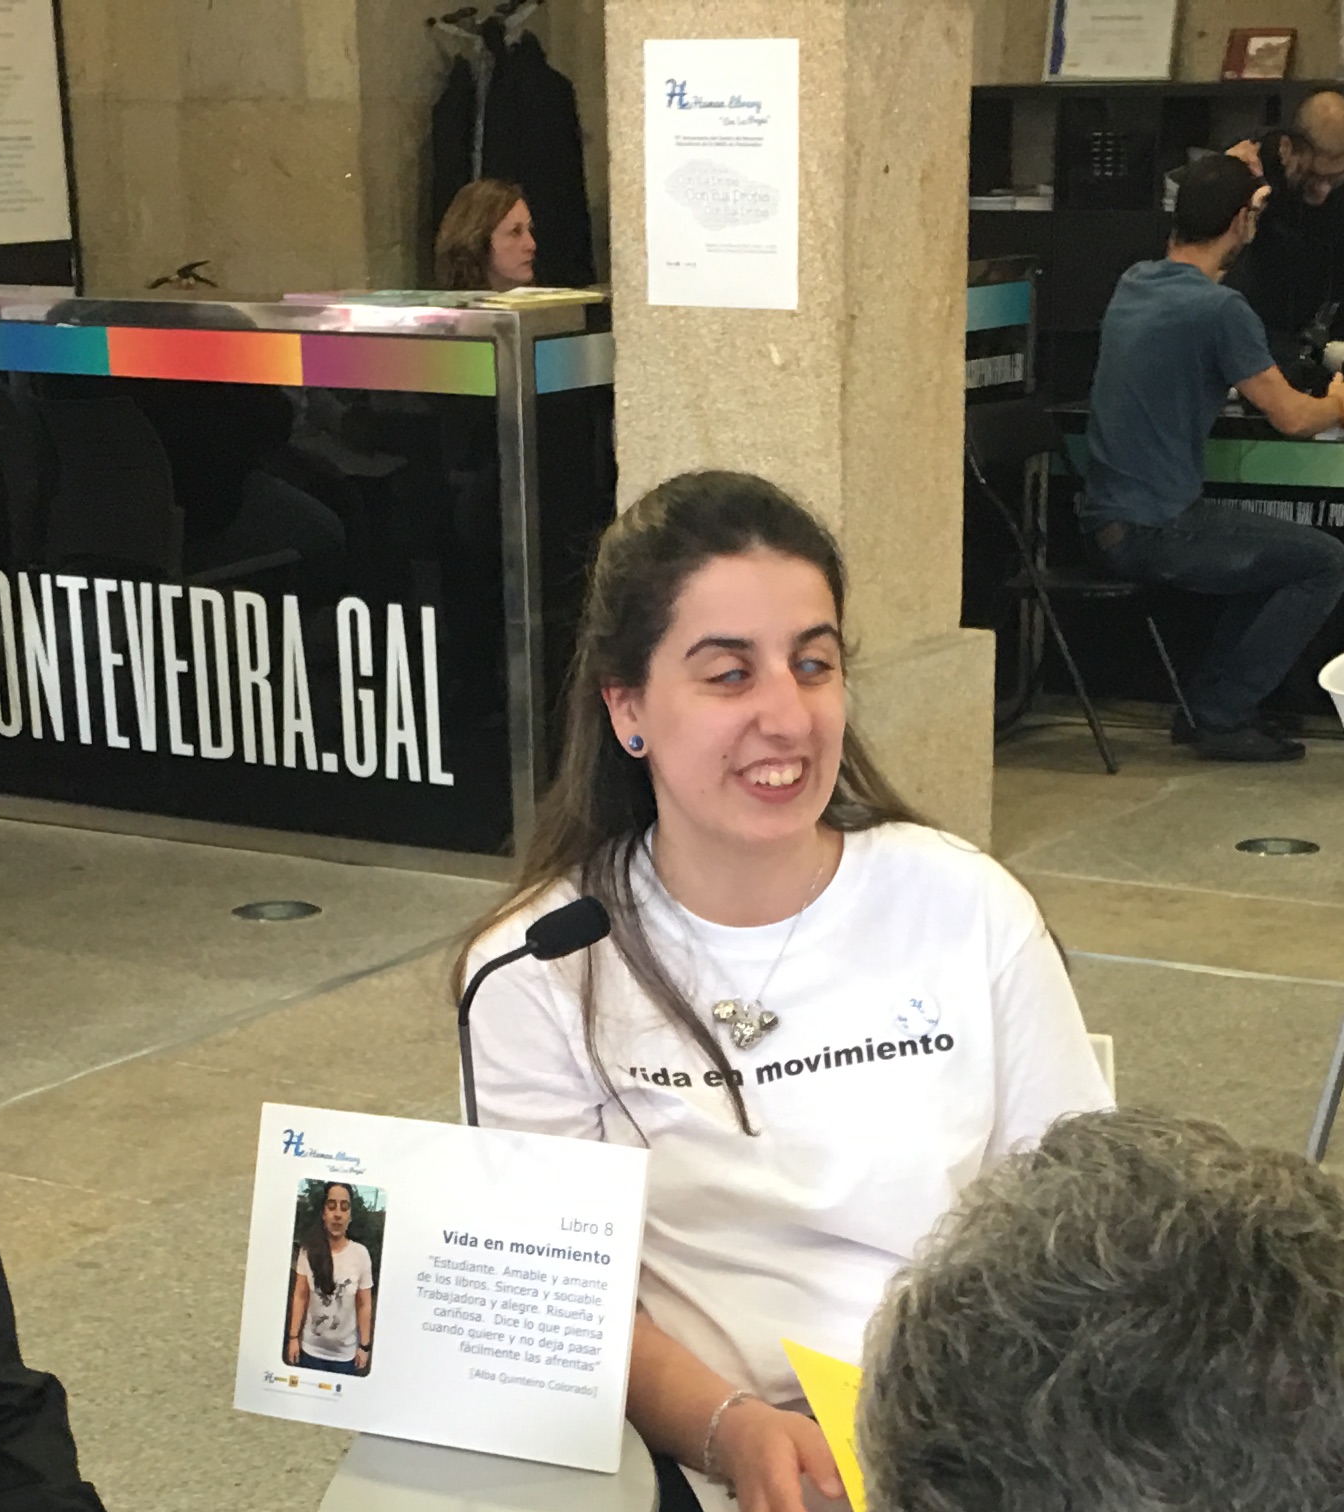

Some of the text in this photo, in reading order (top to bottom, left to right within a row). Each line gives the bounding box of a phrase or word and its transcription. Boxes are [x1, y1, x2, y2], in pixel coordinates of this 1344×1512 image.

[629, 1066, 692, 1088] ida
[755, 1032, 954, 1085] movimiento
[560, 1217, 614, 1237] Libro 8
[443, 1230, 611, 1265] Vida en movimiento
[417, 1271, 604, 1307] de los libros. Sincera y sociable.
[503, 1266, 547, 1282] Amable
[552, 1275, 558, 1285] y
[562, 1275, 608, 1291] amante
[417, 1286, 605, 1325] Trabajadora y alegre. Risueña y
[422, 1321, 602, 1356] cuando quiere y no deja pasar
[433, 1306, 603, 1340] cariñosa. Dice lo que piensa
[460, 1340, 520, 1360] fácilmente
[525, 1351, 541, 1364] las
[499, 1371, 545, 1389] Quinteiro
